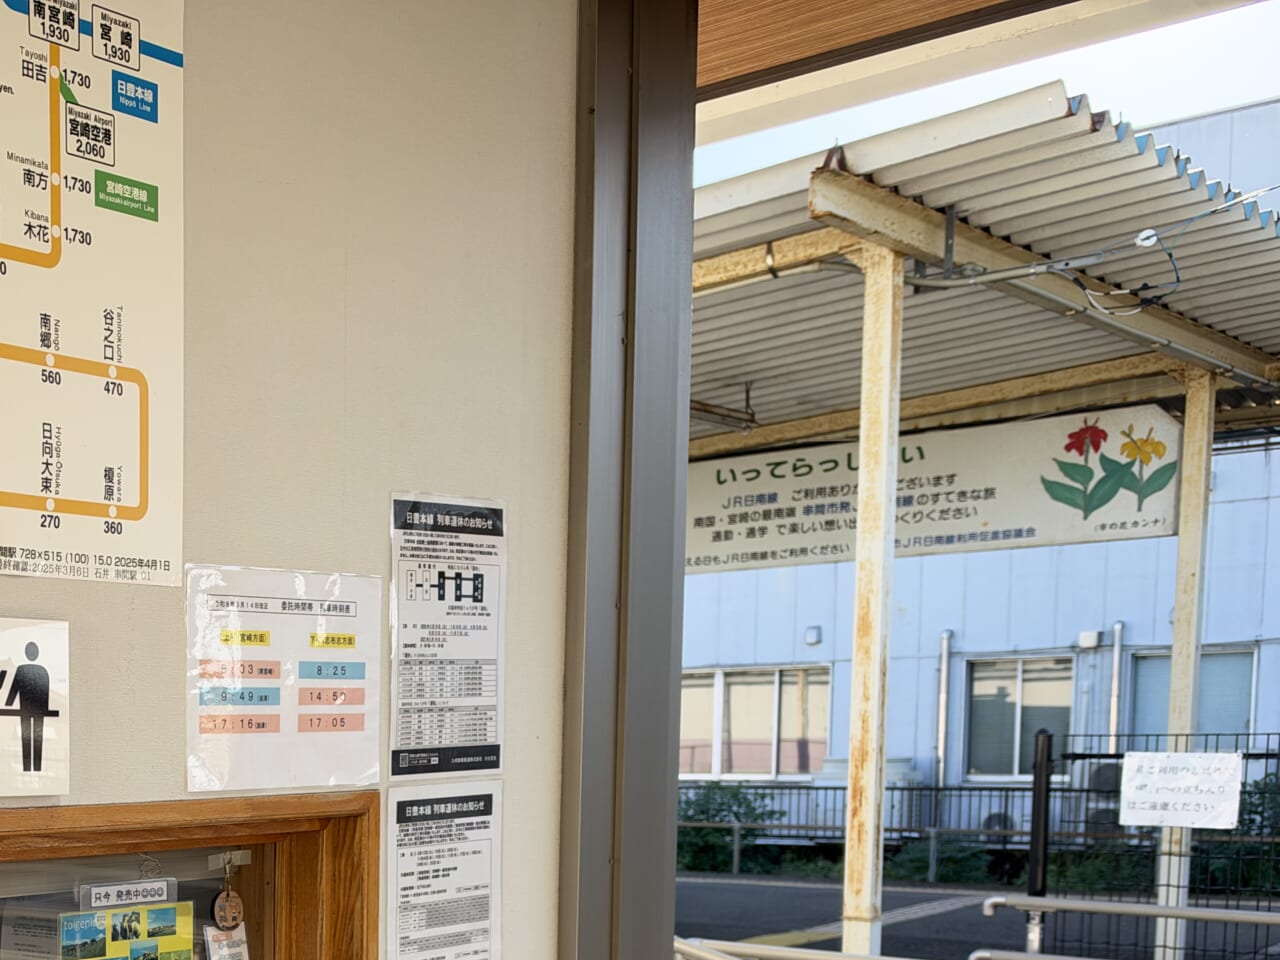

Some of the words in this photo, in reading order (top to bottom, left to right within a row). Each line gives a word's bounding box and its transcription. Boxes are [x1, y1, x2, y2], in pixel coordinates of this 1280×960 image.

[33, 0, 76, 30] 南宮崎
[100, 12, 132, 30] Miyazaki
[39, 23, 70, 43] 1,930
[103, 43, 131, 63] 1,930
[21, 59, 48, 84] 田吉
[62, 68, 91, 89] 1,730
[68, 118, 113, 146] 宮崎空港
[75, 139, 106, 159] 2,060
[6, 151, 49, 170] Minamikata
[22, 168, 49, 191] 南方
[23, 221, 50, 244] 木花
[63, 227, 92, 246] 1,730
[102, 308, 115, 361] 谷之口
[103, 381, 123, 397] 470
[40, 422, 53, 495] 日向大束
[103, 466, 115, 502] 榎原
[40, 514, 61, 529] 270
[114, 556, 171, 572] 2025年4月1日
